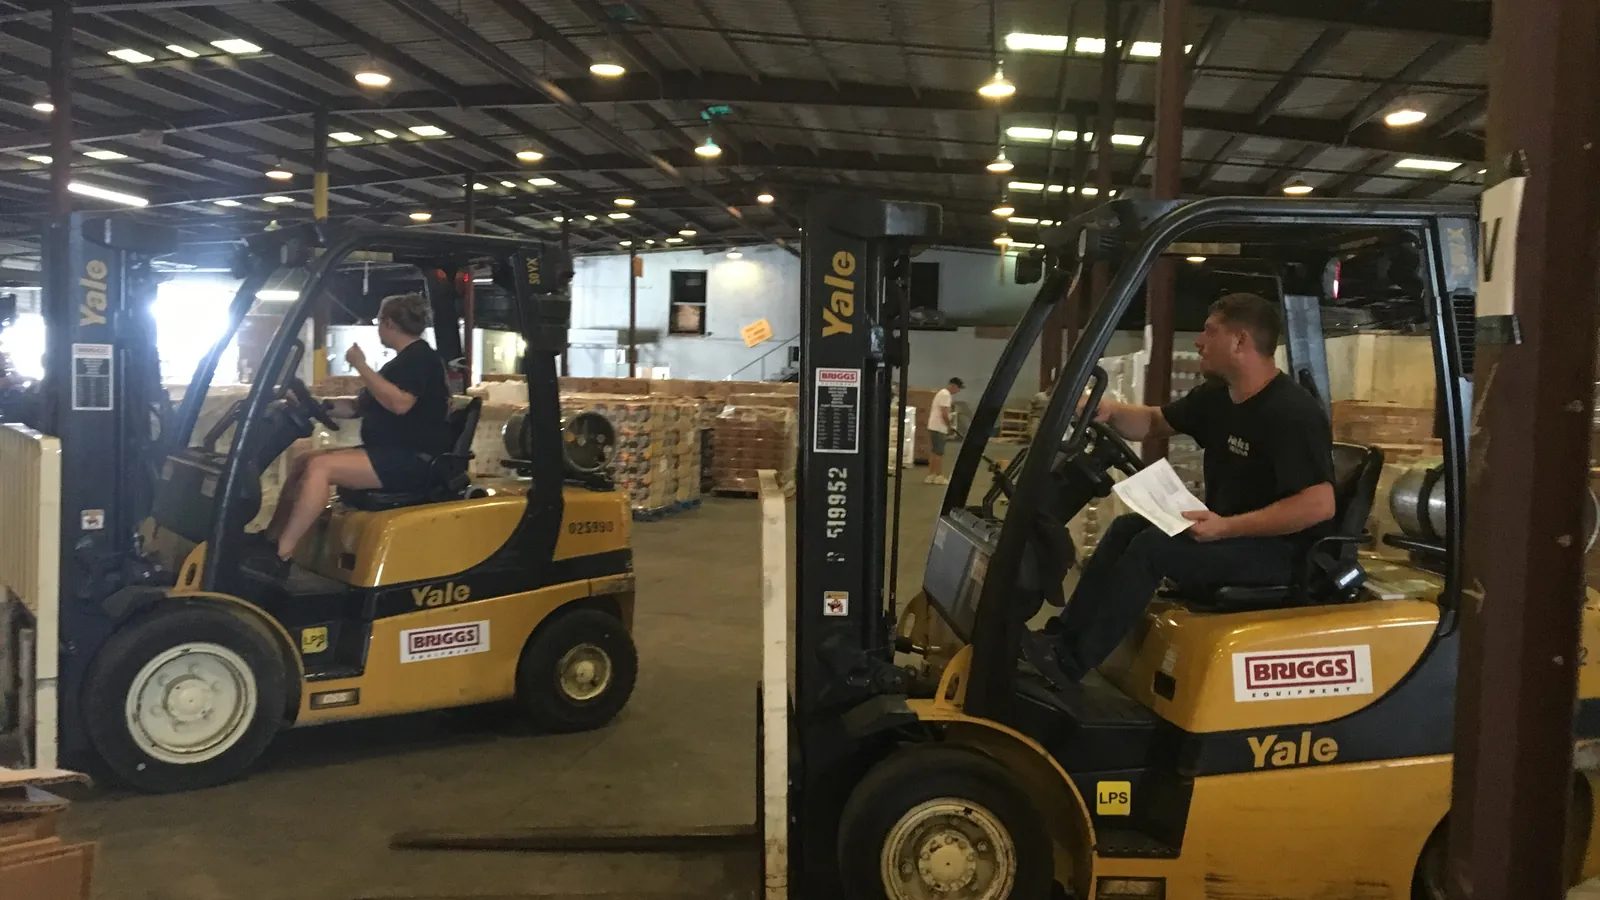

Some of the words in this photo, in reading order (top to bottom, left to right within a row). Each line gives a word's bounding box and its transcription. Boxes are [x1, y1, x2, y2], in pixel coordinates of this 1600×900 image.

[79, 259, 108, 326] Yale
[822, 250, 856, 338] Yale
[821, 372, 855, 381] BRIGGS
[826, 467, 848, 539] 519952
[410, 581, 472, 607] Yale
[413, 628, 476, 650] BRIGGS
[1253, 658, 1349, 682] BRIGGS
[1251, 686, 1352, 698] EQUIPMENT
[1247, 731, 1339, 768] Yale
[1099, 791, 1129, 805] LPS
